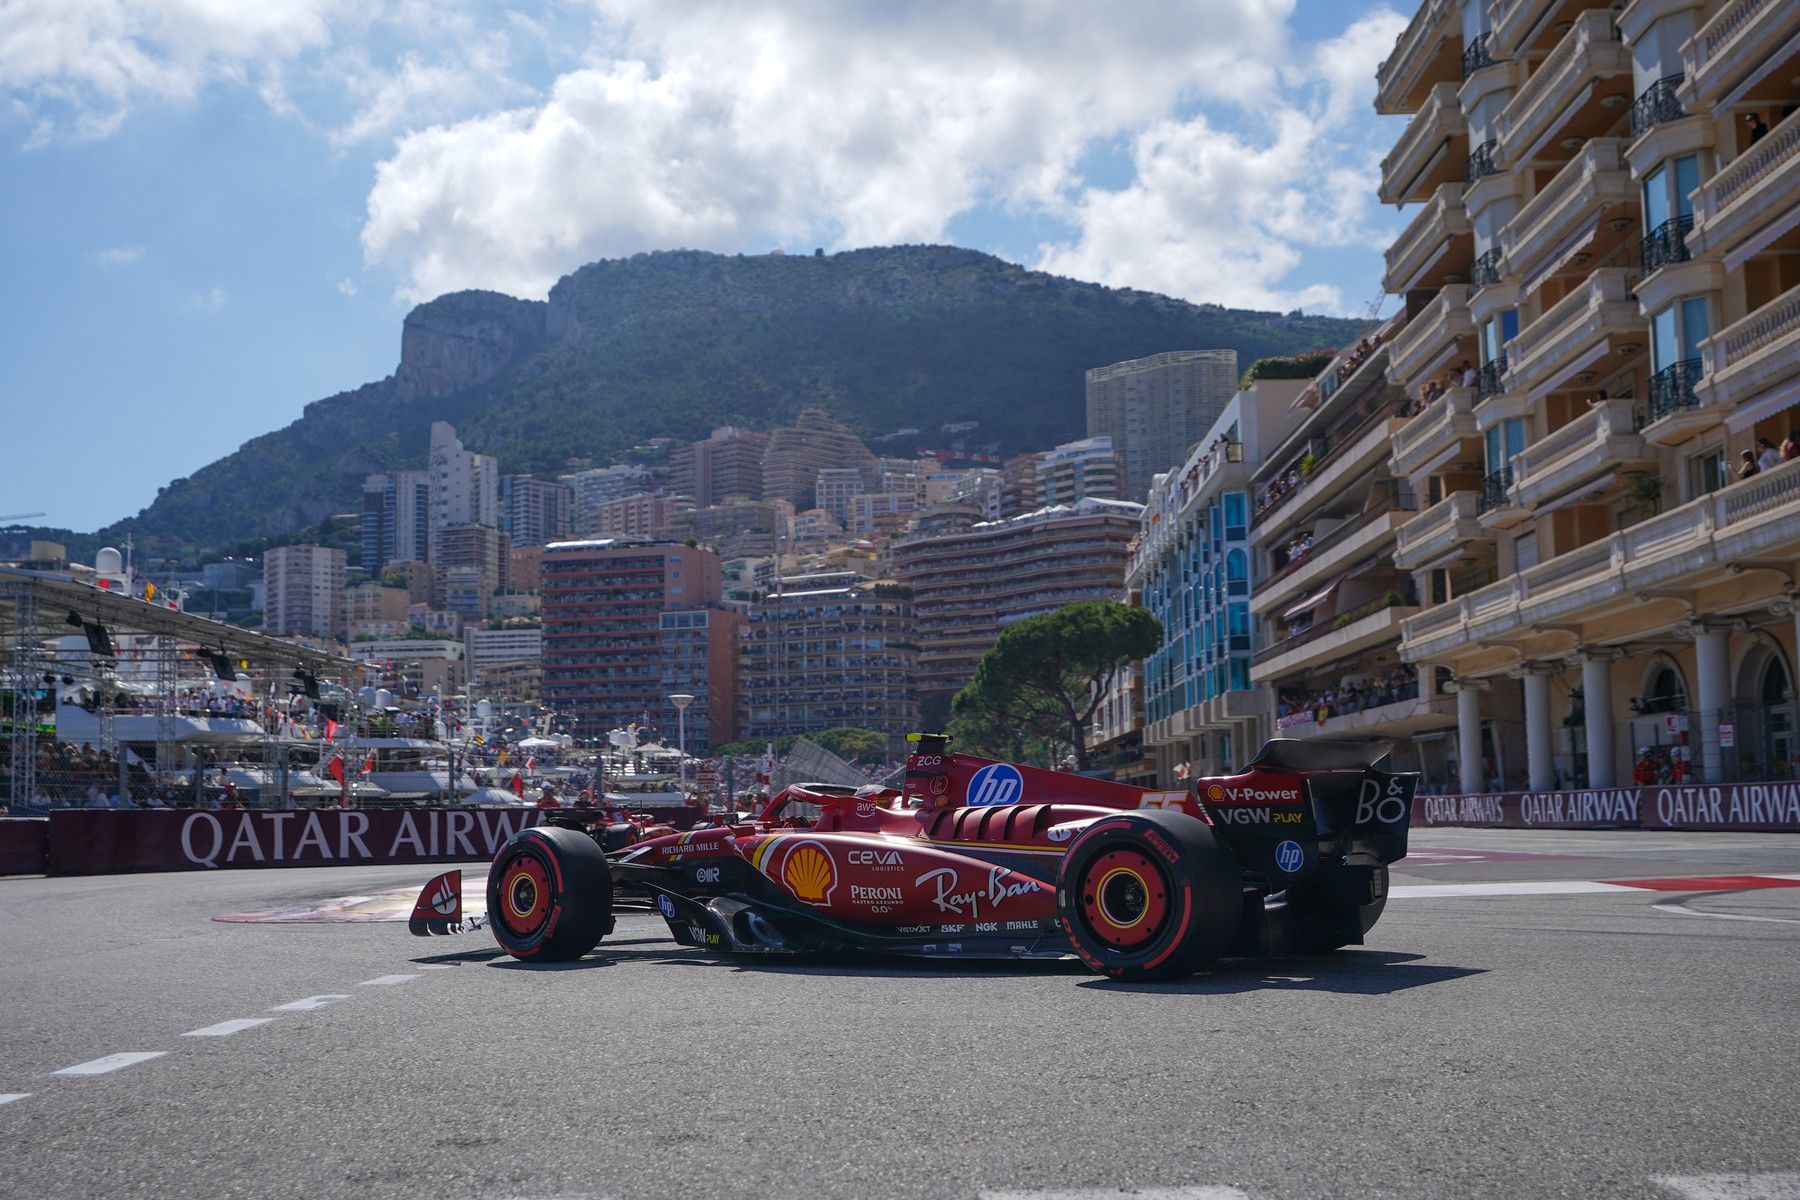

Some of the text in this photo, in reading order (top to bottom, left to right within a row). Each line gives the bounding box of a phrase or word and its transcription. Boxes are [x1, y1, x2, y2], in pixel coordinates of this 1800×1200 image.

[917, 756, 941, 766] ZCG
[971, 763, 1019, 806] hp
[1225, 788, 1298, 800] V-Power
[857, 802, 876, 811] aws
[1425, 797, 1458, 823] QATAR
[1521, 790, 1640, 825] QATAR AIRWAY
[1657, 784, 1800, 826] QATAR AIRWA
[1218, 808, 1302, 824] VGW PLAY
[182, 811, 546, 867] QATAR AIRW
[662, 842, 719, 854] RICHARD MILLE
[1278, 841, 1301, 872] hp
[850, 885, 903, 899] PERONI
[660, 895, 674, 917] hp
[976, 922, 998, 931] NGK
[1006, 920, 1038, 930] MAHLE
